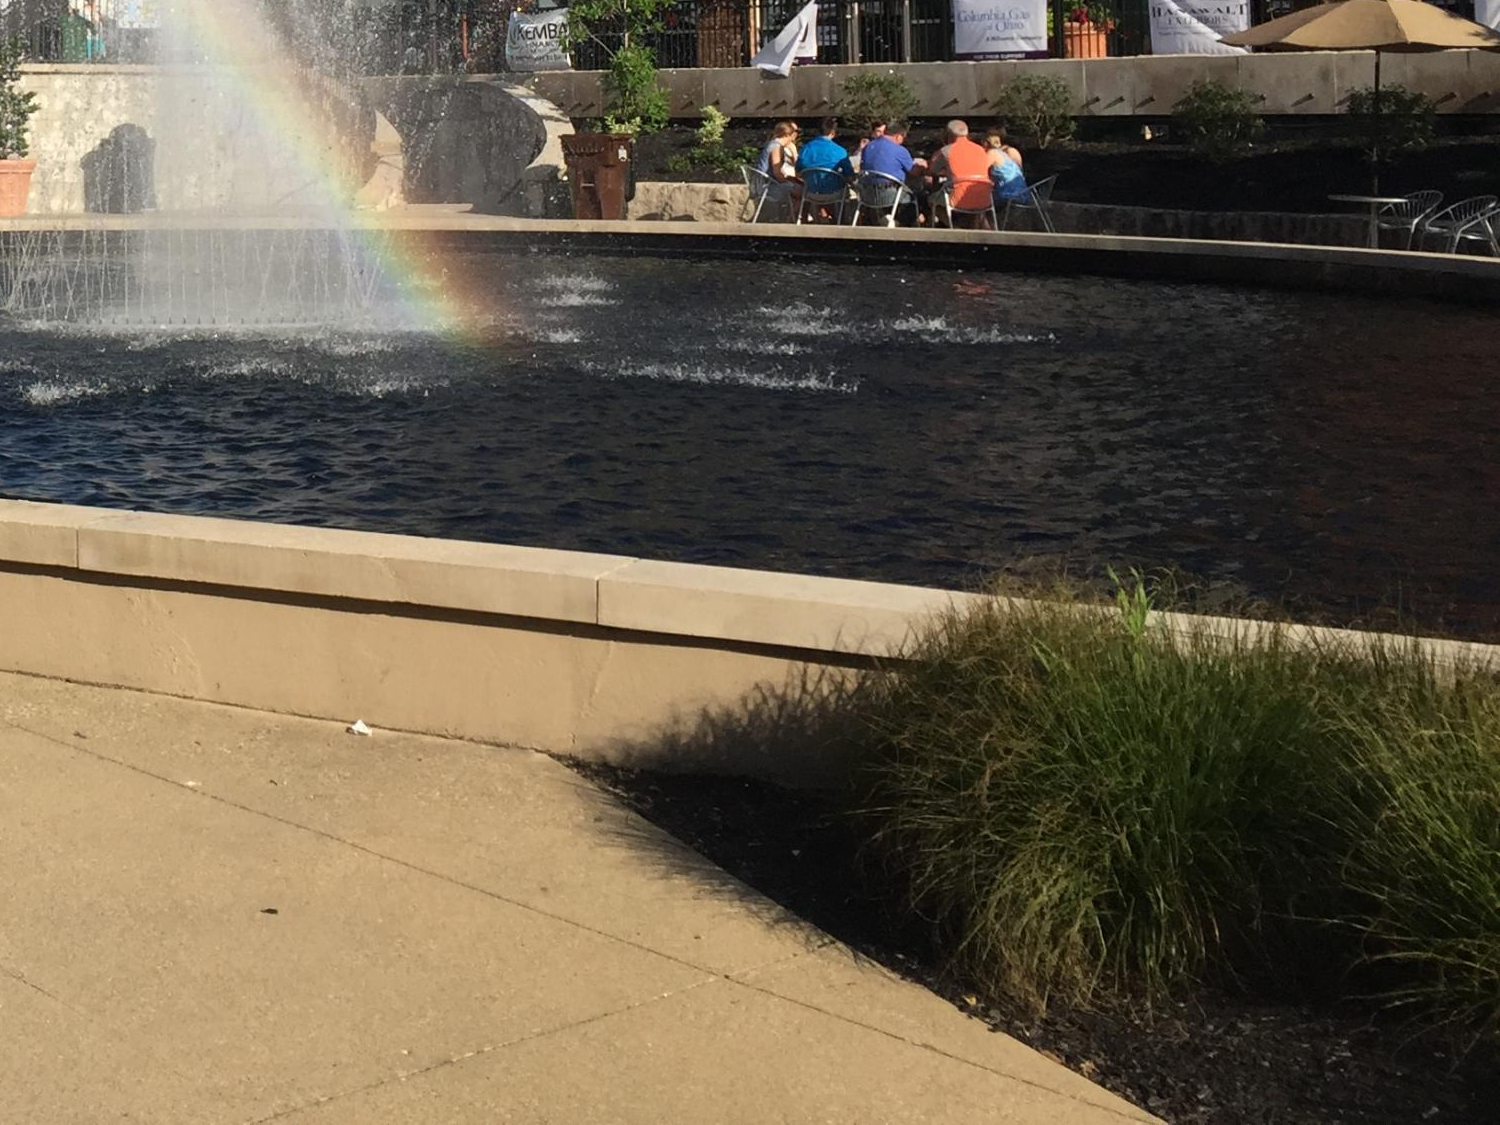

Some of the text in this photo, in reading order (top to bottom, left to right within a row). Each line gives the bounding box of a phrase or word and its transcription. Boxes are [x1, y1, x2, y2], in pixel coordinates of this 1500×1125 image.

[958, 9, 1030, 23] Columbia Gas
[517, 22, 568, 41] KEMBA
[996, 20, 1025, 32] Ohio
